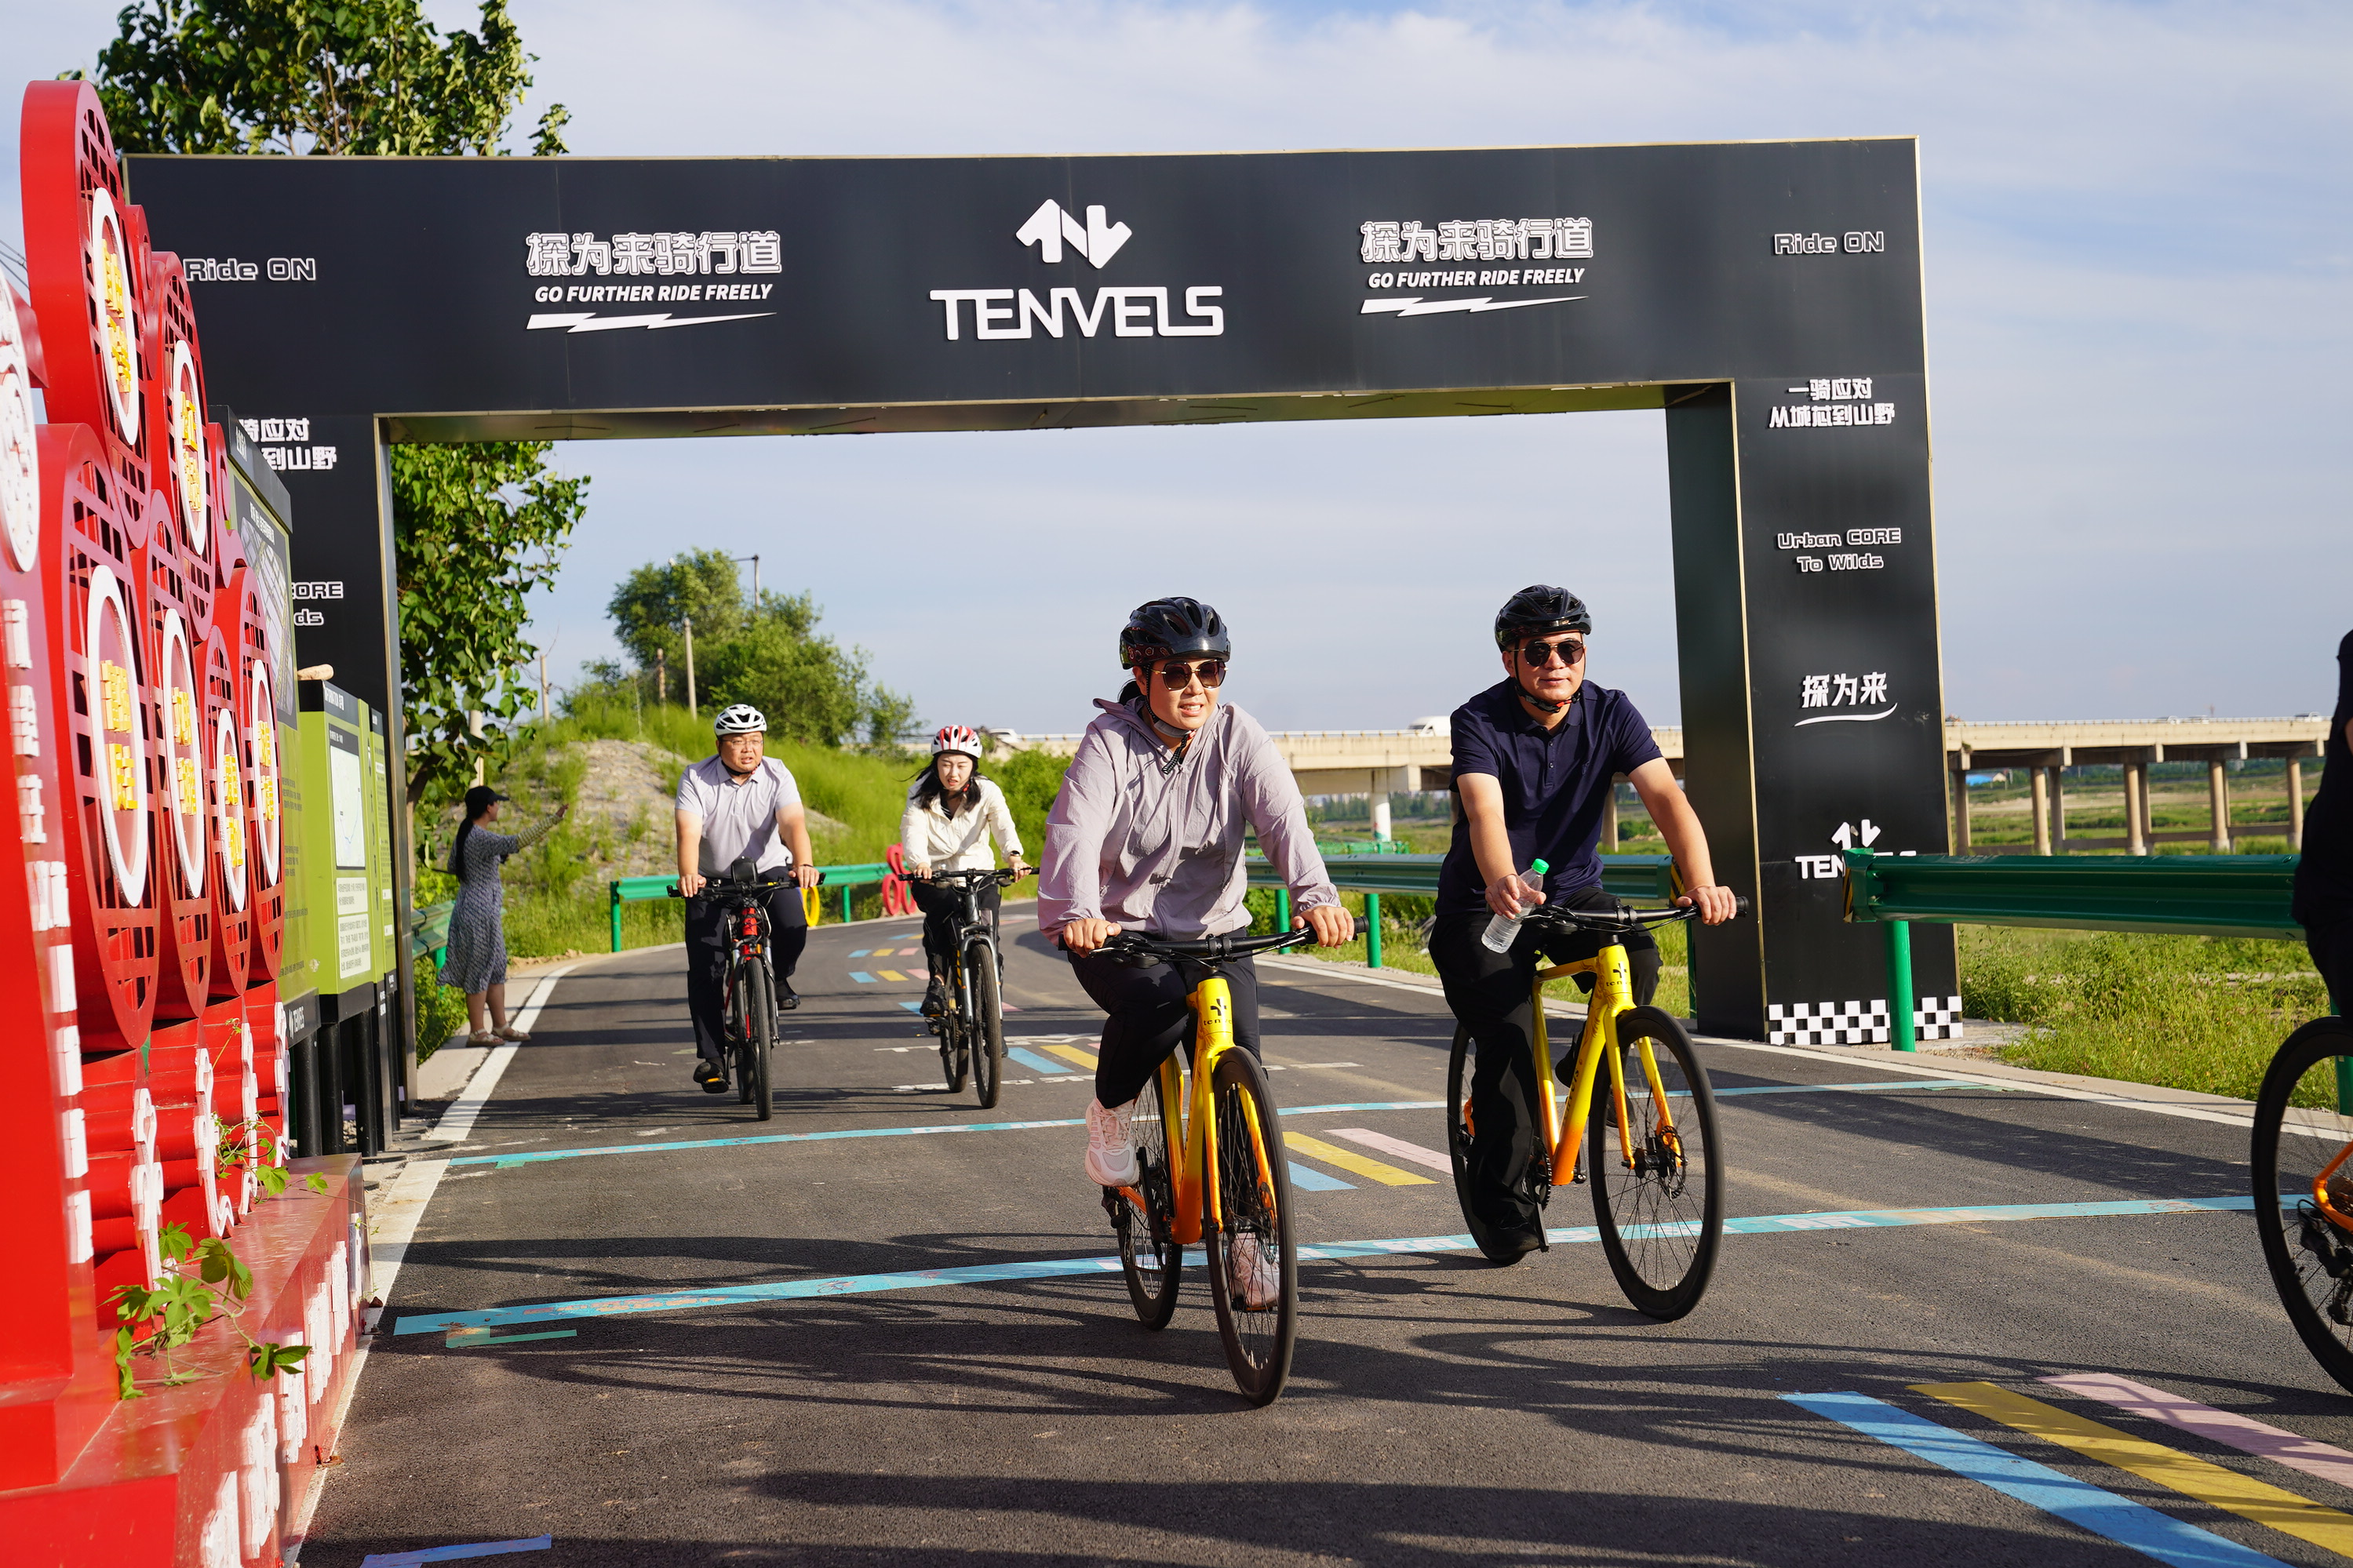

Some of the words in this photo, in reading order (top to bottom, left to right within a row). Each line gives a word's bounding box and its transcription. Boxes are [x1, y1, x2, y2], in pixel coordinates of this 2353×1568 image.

[1360, 216, 1594, 262] 探为来骑行道
[1775, 233, 1837, 254] Ride
[1845, 231, 1884, 253] ON
[526, 231, 782, 275] 探为来骑行道
[183, 258, 258, 281] Ride
[267, 258, 315, 281] ON
[1368, 272, 1394, 289] GO
[1397, 271, 1476, 288] FURTHER
[1479, 270, 1520, 286] RIDE
[1522, 268, 1586, 285] FREELY
[534, 286, 563, 303] GO
[566, 285, 654, 303] FURTHER
[657, 286, 702, 301] RIDE
[705, 284, 774, 300] FREELY
[930, 286, 1224, 340] TENVELS
[1788, 377, 1873, 401] 一骑应对
[1769, 403, 1896, 428] 从城芯到山野
[1778, 532, 1842, 550] Urban
[1846, 527, 1902, 545] CORE
[1797, 556, 1823, 573] To
[1828, 553, 1884, 571] Wilds
[291, 581, 344, 599] ORE
[1801, 671, 1888, 708] 探为来
